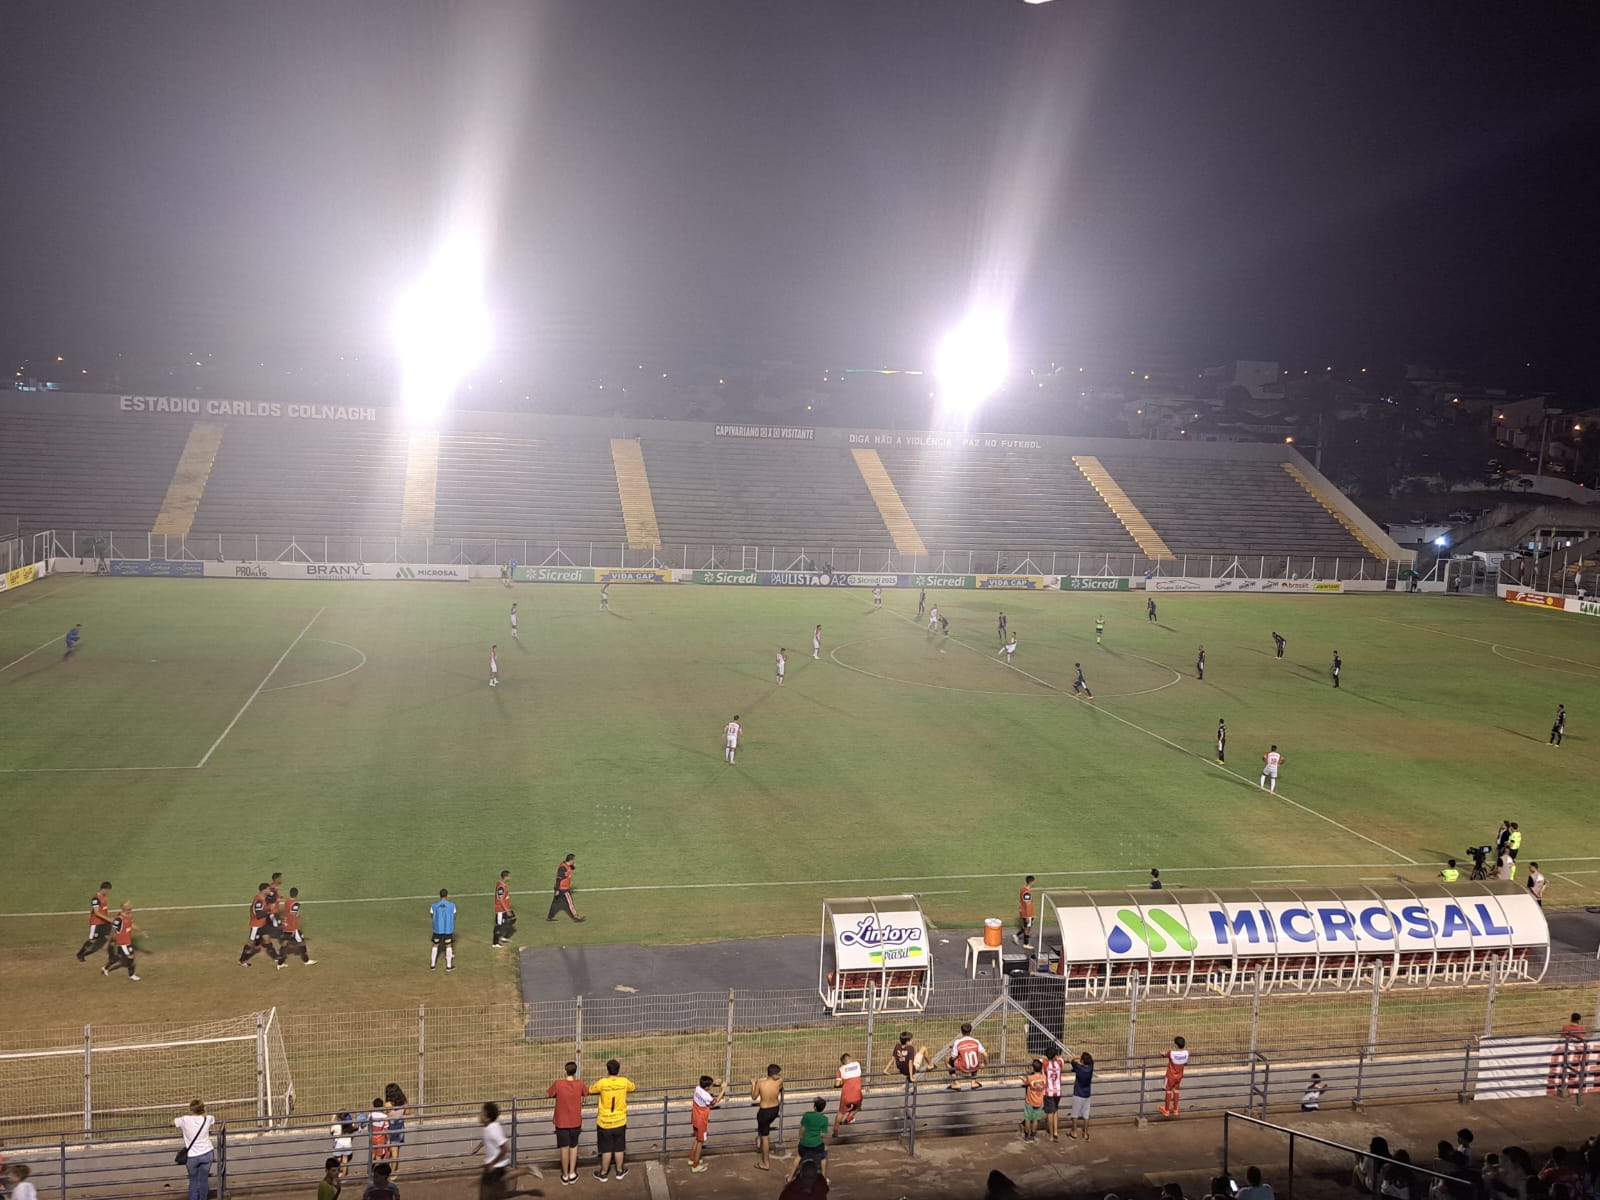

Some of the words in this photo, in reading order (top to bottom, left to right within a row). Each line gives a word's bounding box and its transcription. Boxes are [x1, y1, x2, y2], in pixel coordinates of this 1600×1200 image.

[206, 400, 281, 417] CARLOS
[287, 404, 376, 421] COLNAGHI
[849, 433, 870, 444] DIGA
[985, 439, 997, 448] NO
[1001, 439, 1041, 449] FUTEBOL
[307, 565, 371, 575] BRANYL
[417, 569, 458, 577] MICROSAL
[538, 568, 582, 581] Sicredi
[715, 571, 757, 584] Sicredi
[831, 575, 847, 586] A2
[926, 575, 965, 587] Sicredi
[1081, 578, 1119, 589] Sicredi
[1209, 904, 1513, 944] MICROSAL
[840, 916, 921, 948] Lindoya
[882, 947, 909, 960] rasil
[964, 1051, 978, 1069] 10
[611, 1096, 616, 1113] 1
